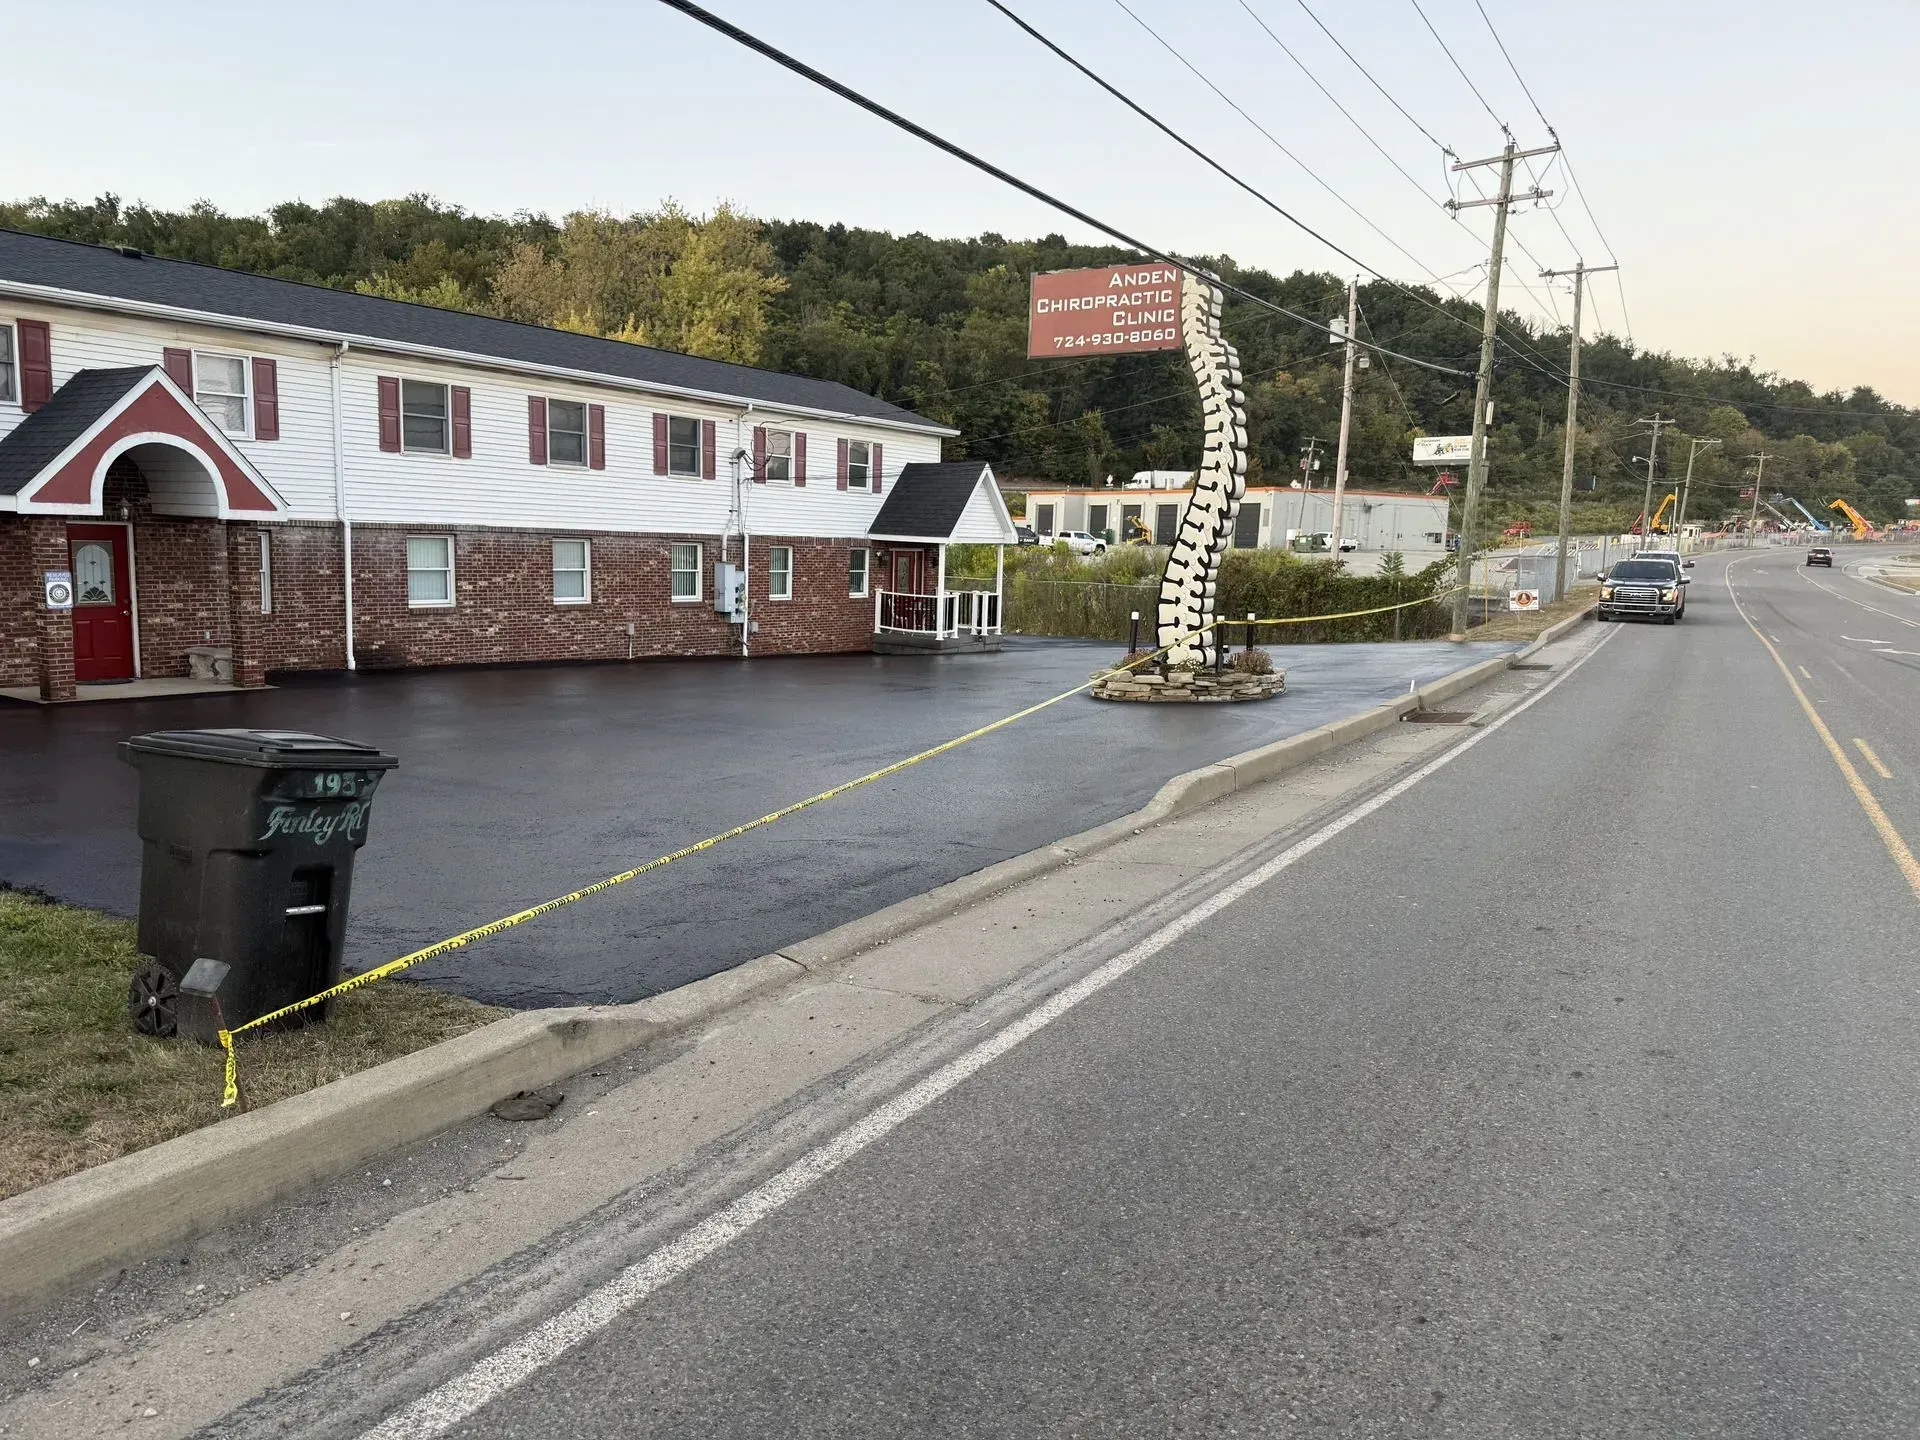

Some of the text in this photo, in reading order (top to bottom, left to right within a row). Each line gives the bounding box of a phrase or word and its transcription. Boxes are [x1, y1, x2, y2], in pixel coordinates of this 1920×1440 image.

[1108, 269, 1177, 288] ANDEN
[1037, 289, 1173, 314] CHIROPRACTIC
[1112, 309, 1175, 326] CLINIC
[1053, 328, 1176, 348] 724-930-8060
[257, 806, 340, 846] Finley
